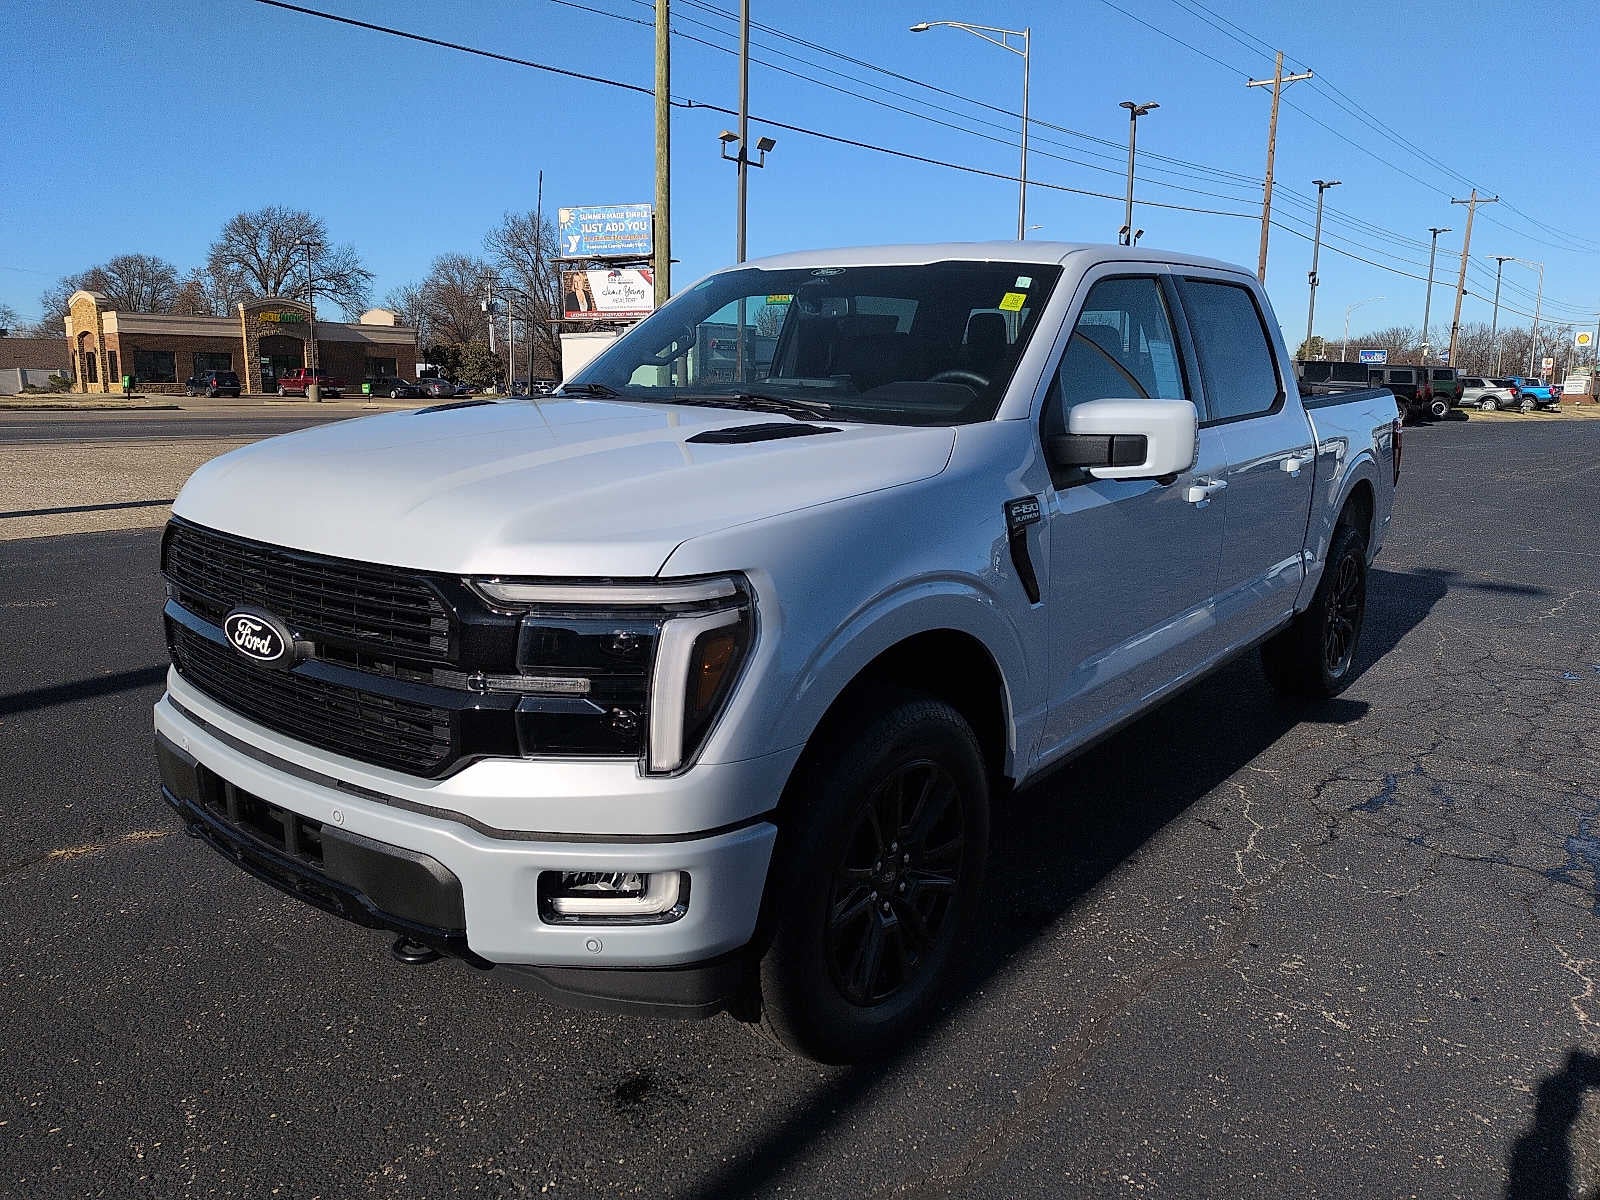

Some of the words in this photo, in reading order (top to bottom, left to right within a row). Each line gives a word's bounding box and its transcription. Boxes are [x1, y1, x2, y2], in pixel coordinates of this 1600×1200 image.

[580, 213, 606, 221] SUMMER
[606, 212, 624, 220] MADE
[581, 223, 603, 233] JUST
[605, 222, 625, 232] ADD
[626, 221, 647, 231] YOU
[234, 618, 272, 655] Ford
